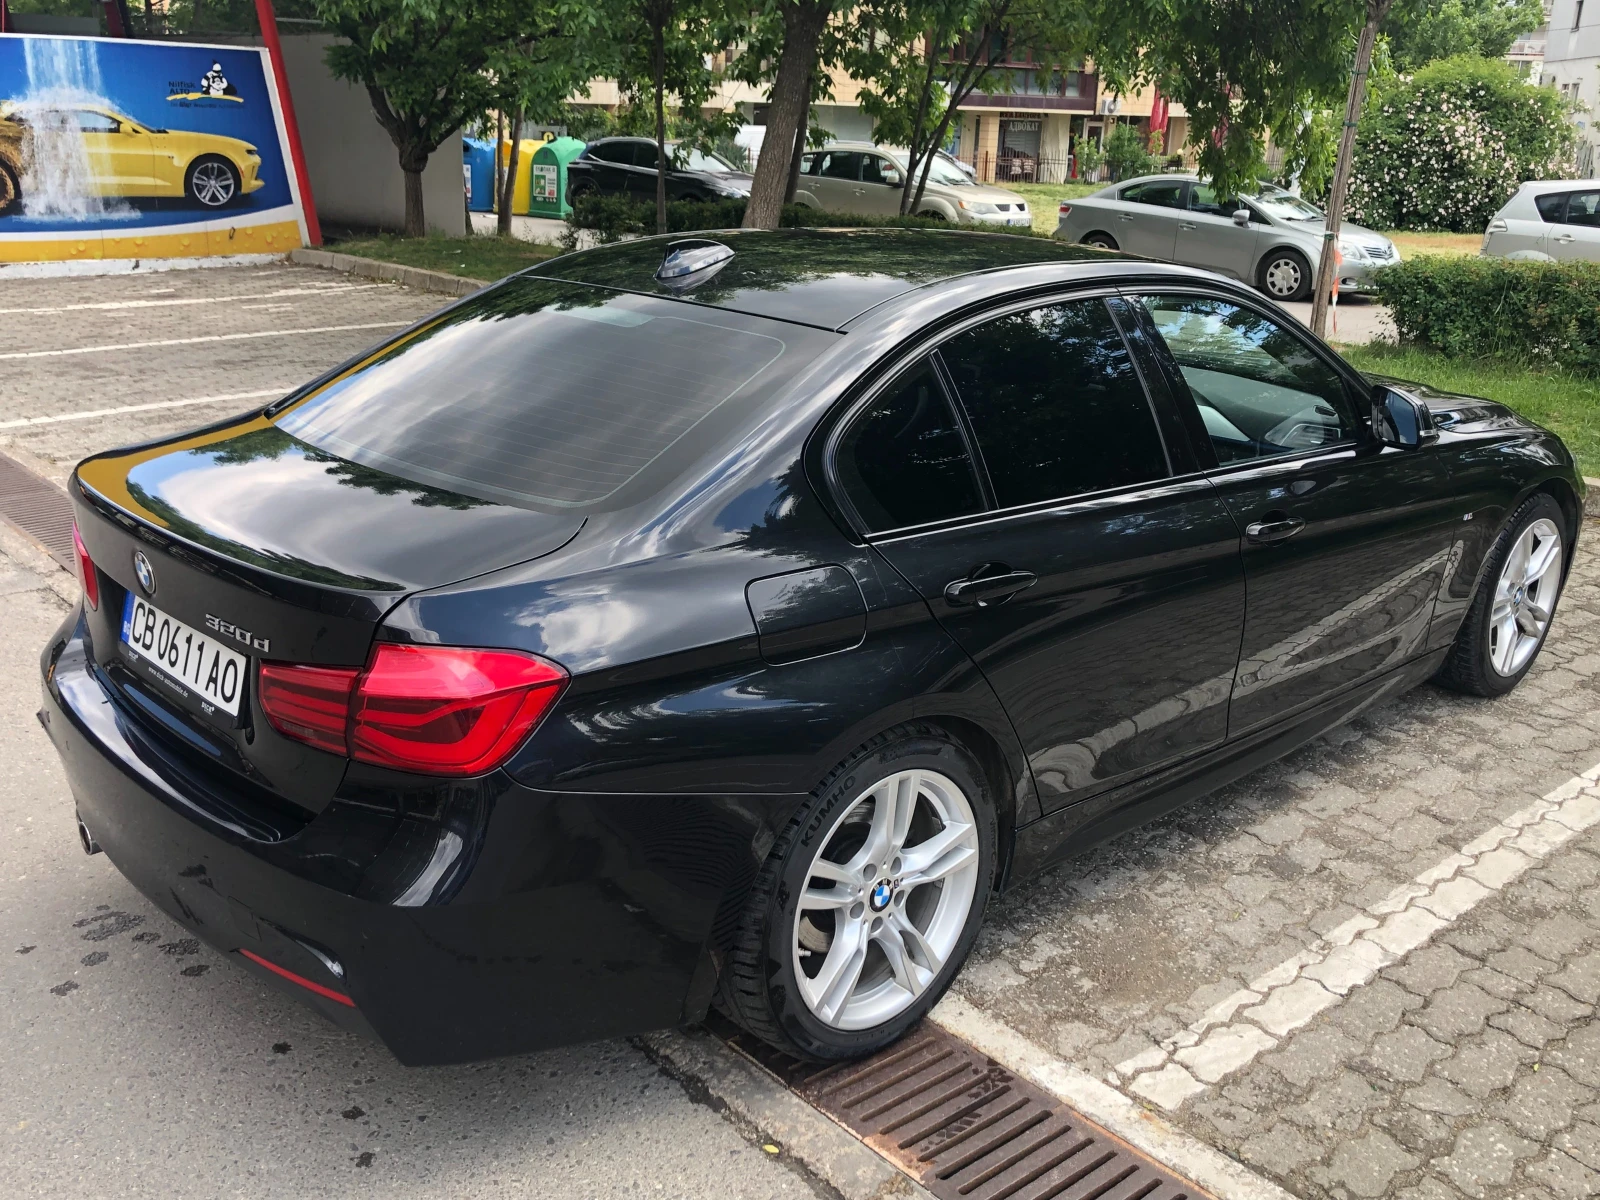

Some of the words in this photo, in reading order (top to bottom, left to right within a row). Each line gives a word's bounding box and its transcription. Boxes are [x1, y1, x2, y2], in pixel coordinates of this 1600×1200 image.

[1008, 121, 1040, 132] АДВОКАТ
[205, 612, 271, 653] 320d
[800, 775, 856, 848] KUMHO
